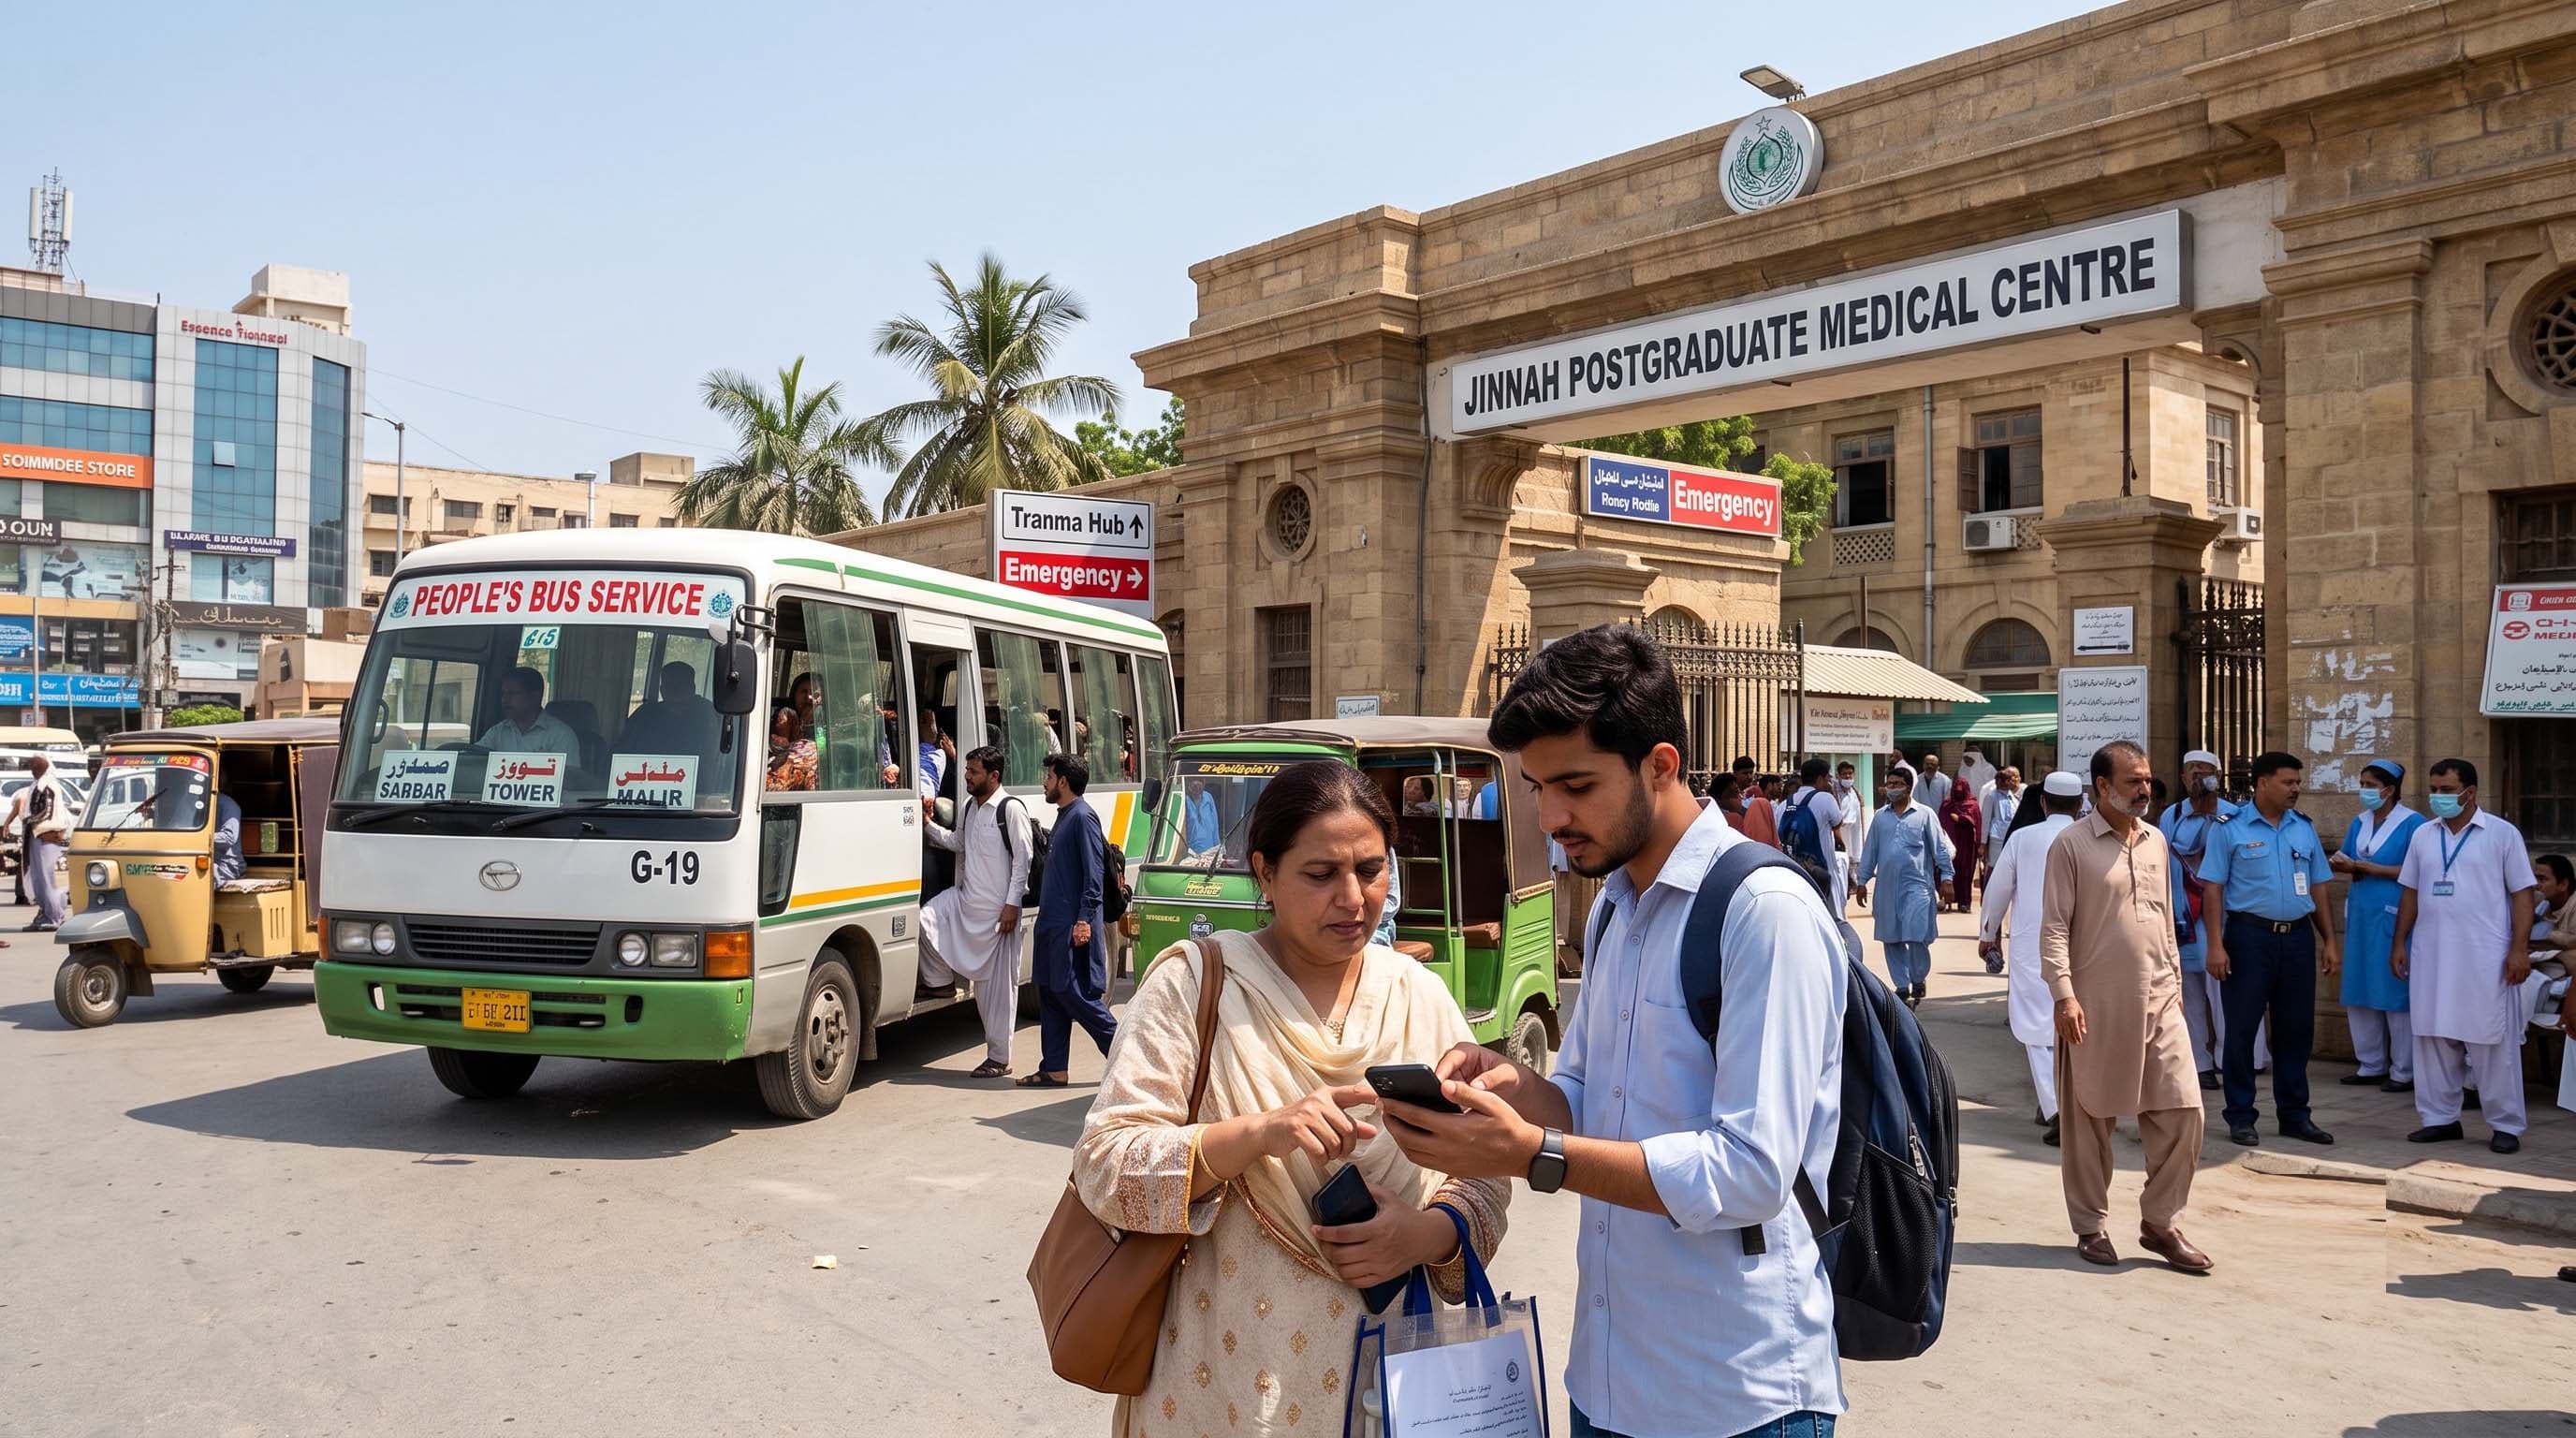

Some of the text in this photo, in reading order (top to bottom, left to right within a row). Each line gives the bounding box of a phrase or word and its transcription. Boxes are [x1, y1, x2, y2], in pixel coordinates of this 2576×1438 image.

[1464, 237, 2156, 416] JINNAH POSTGRADUATE MEDICAL CENTRE
[87, 461, 136, 478] STORE
[1675, 479, 1775, 526] Emergency
[1011, 506, 1125, 536] Tranma Hub
[1004, 556, 1122, 593] Emergency
[411, 580, 705, 617] PEOPLE'S BUS SERVICE
[489, 783, 555, 802] TOWER
[631, 850, 699, 885] G-19
